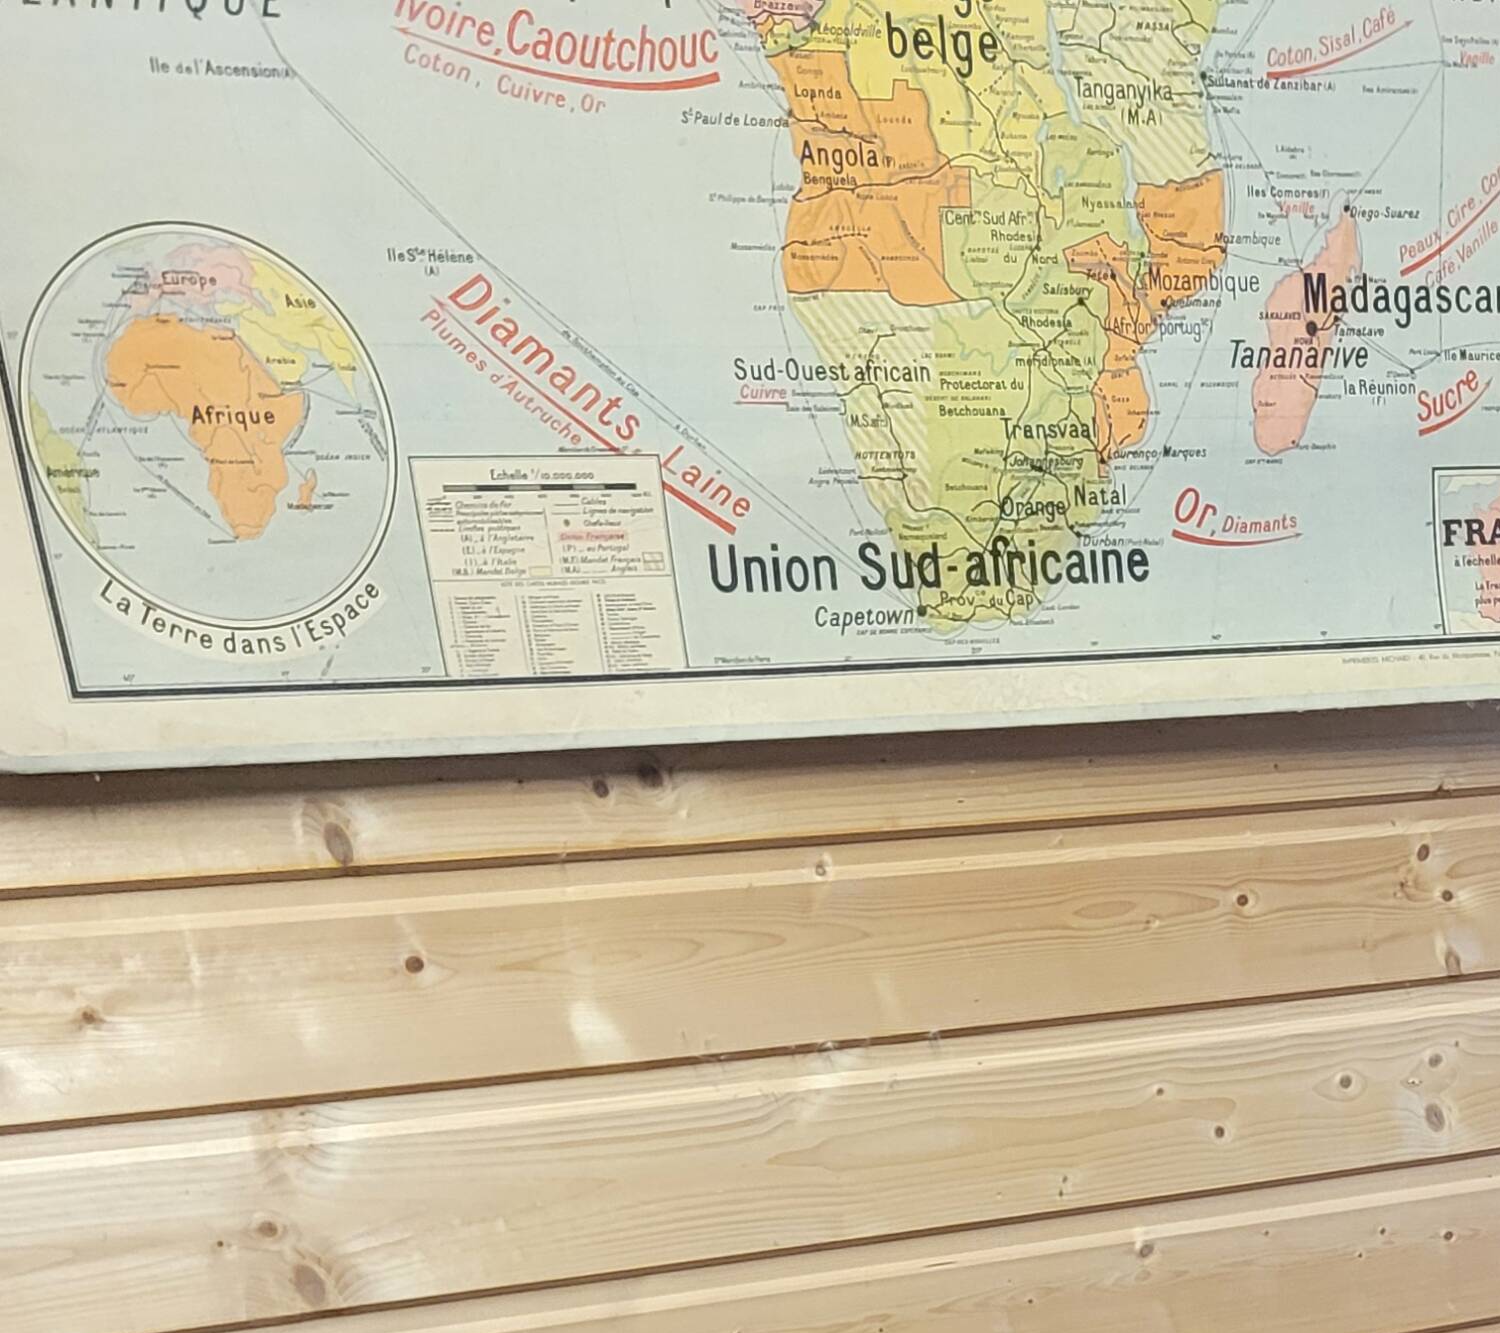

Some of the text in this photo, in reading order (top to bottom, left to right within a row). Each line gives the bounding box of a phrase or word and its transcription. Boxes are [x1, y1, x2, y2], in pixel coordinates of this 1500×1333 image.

[506, 8, 720, 73] Caoutchouc
[885, 11, 998, 78] belge
[1267, 6, 1397, 68] Coton, Sisal, Café
[149, 56, 171, 74] Ile
[404, 43, 607, 114] Coton, Cuivre, Or
[1207, 74, 1254, 90] Sultanat
[1257, 77, 1270, 90] de
[794, 85, 842, 100] Loanda
[1074, 76, 1173, 107] Tanganyika
[694, 109, 723, 126] Paul
[725, 113, 740, 126] de
[743, 114, 790, 128] Loanda
[801, 139, 880, 174] Angola
[803, 171, 858, 192] Benguela
[1247, 185, 1266, 198] Iles
[1081, 195, 1145, 212] Nyassaland
[983, 210, 1006, 226] Sud
[1350, 205, 1420, 222] Diego-Suarez
[990, 229, 1043, 243] Rhodesia
[1214, 232, 1282, 247] Mozambique
[387, 247, 404, 262] Ile
[427, 249, 475, 265] Hélène
[1003, 254, 1017, 263] du
[1032, 254, 1059, 265] Nord
[162, 273, 217, 290] Europe
[1149, 267, 1260, 300] Mozambique
[1042, 282, 1094, 300] Salisbury
[285, 294, 317, 310] Asie
[1021, 315, 1073, 329] Rhodesia
[1334, 324, 1385, 337] Tamatave
[447, 273, 641, 442] Diamants
[1015, 355, 1082, 367] méridionale
[1229, 338, 1368, 369] Tananarive
[1444, 349, 1457, 361] Ile
[420, 308, 582, 447] Plumes d'Autruche
[734, 358, 932, 383] Sud-Ouest africain
[741, 384, 787, 400] Cuivre
[940, 378, 1024, 391] Protectorat du
[1343, 380, 1356, 396] la
[1358, 379, 1416, 396] Réunion
[1417, 369, 1480, 423] Sucre
[191, 404, 276, 432] Afrique
[939, 404, 1006, 417] Betchouana
[1000, 415, 1097, 440] Transvaal
[1009, 456, 1084, 470] Johannesburg
[661, 445, 751, 518] Laine
[1074, 483, 1127, 507] Natal
[1001, 496, 1066, 523] Orange
[1221, 513, 1298, 535] Diamants
[1082, 534, 1125, 548] Durban
[708, 543, 838, 593] Union
[1454, 553, 1461, 568] à
[989, 594, 1003, 606] du
[1005, 588, 1034, 611] Cap
[100, 580, 381, 655] La Terre dans l'Espace
[815, 605, 914, 636] Capetown
